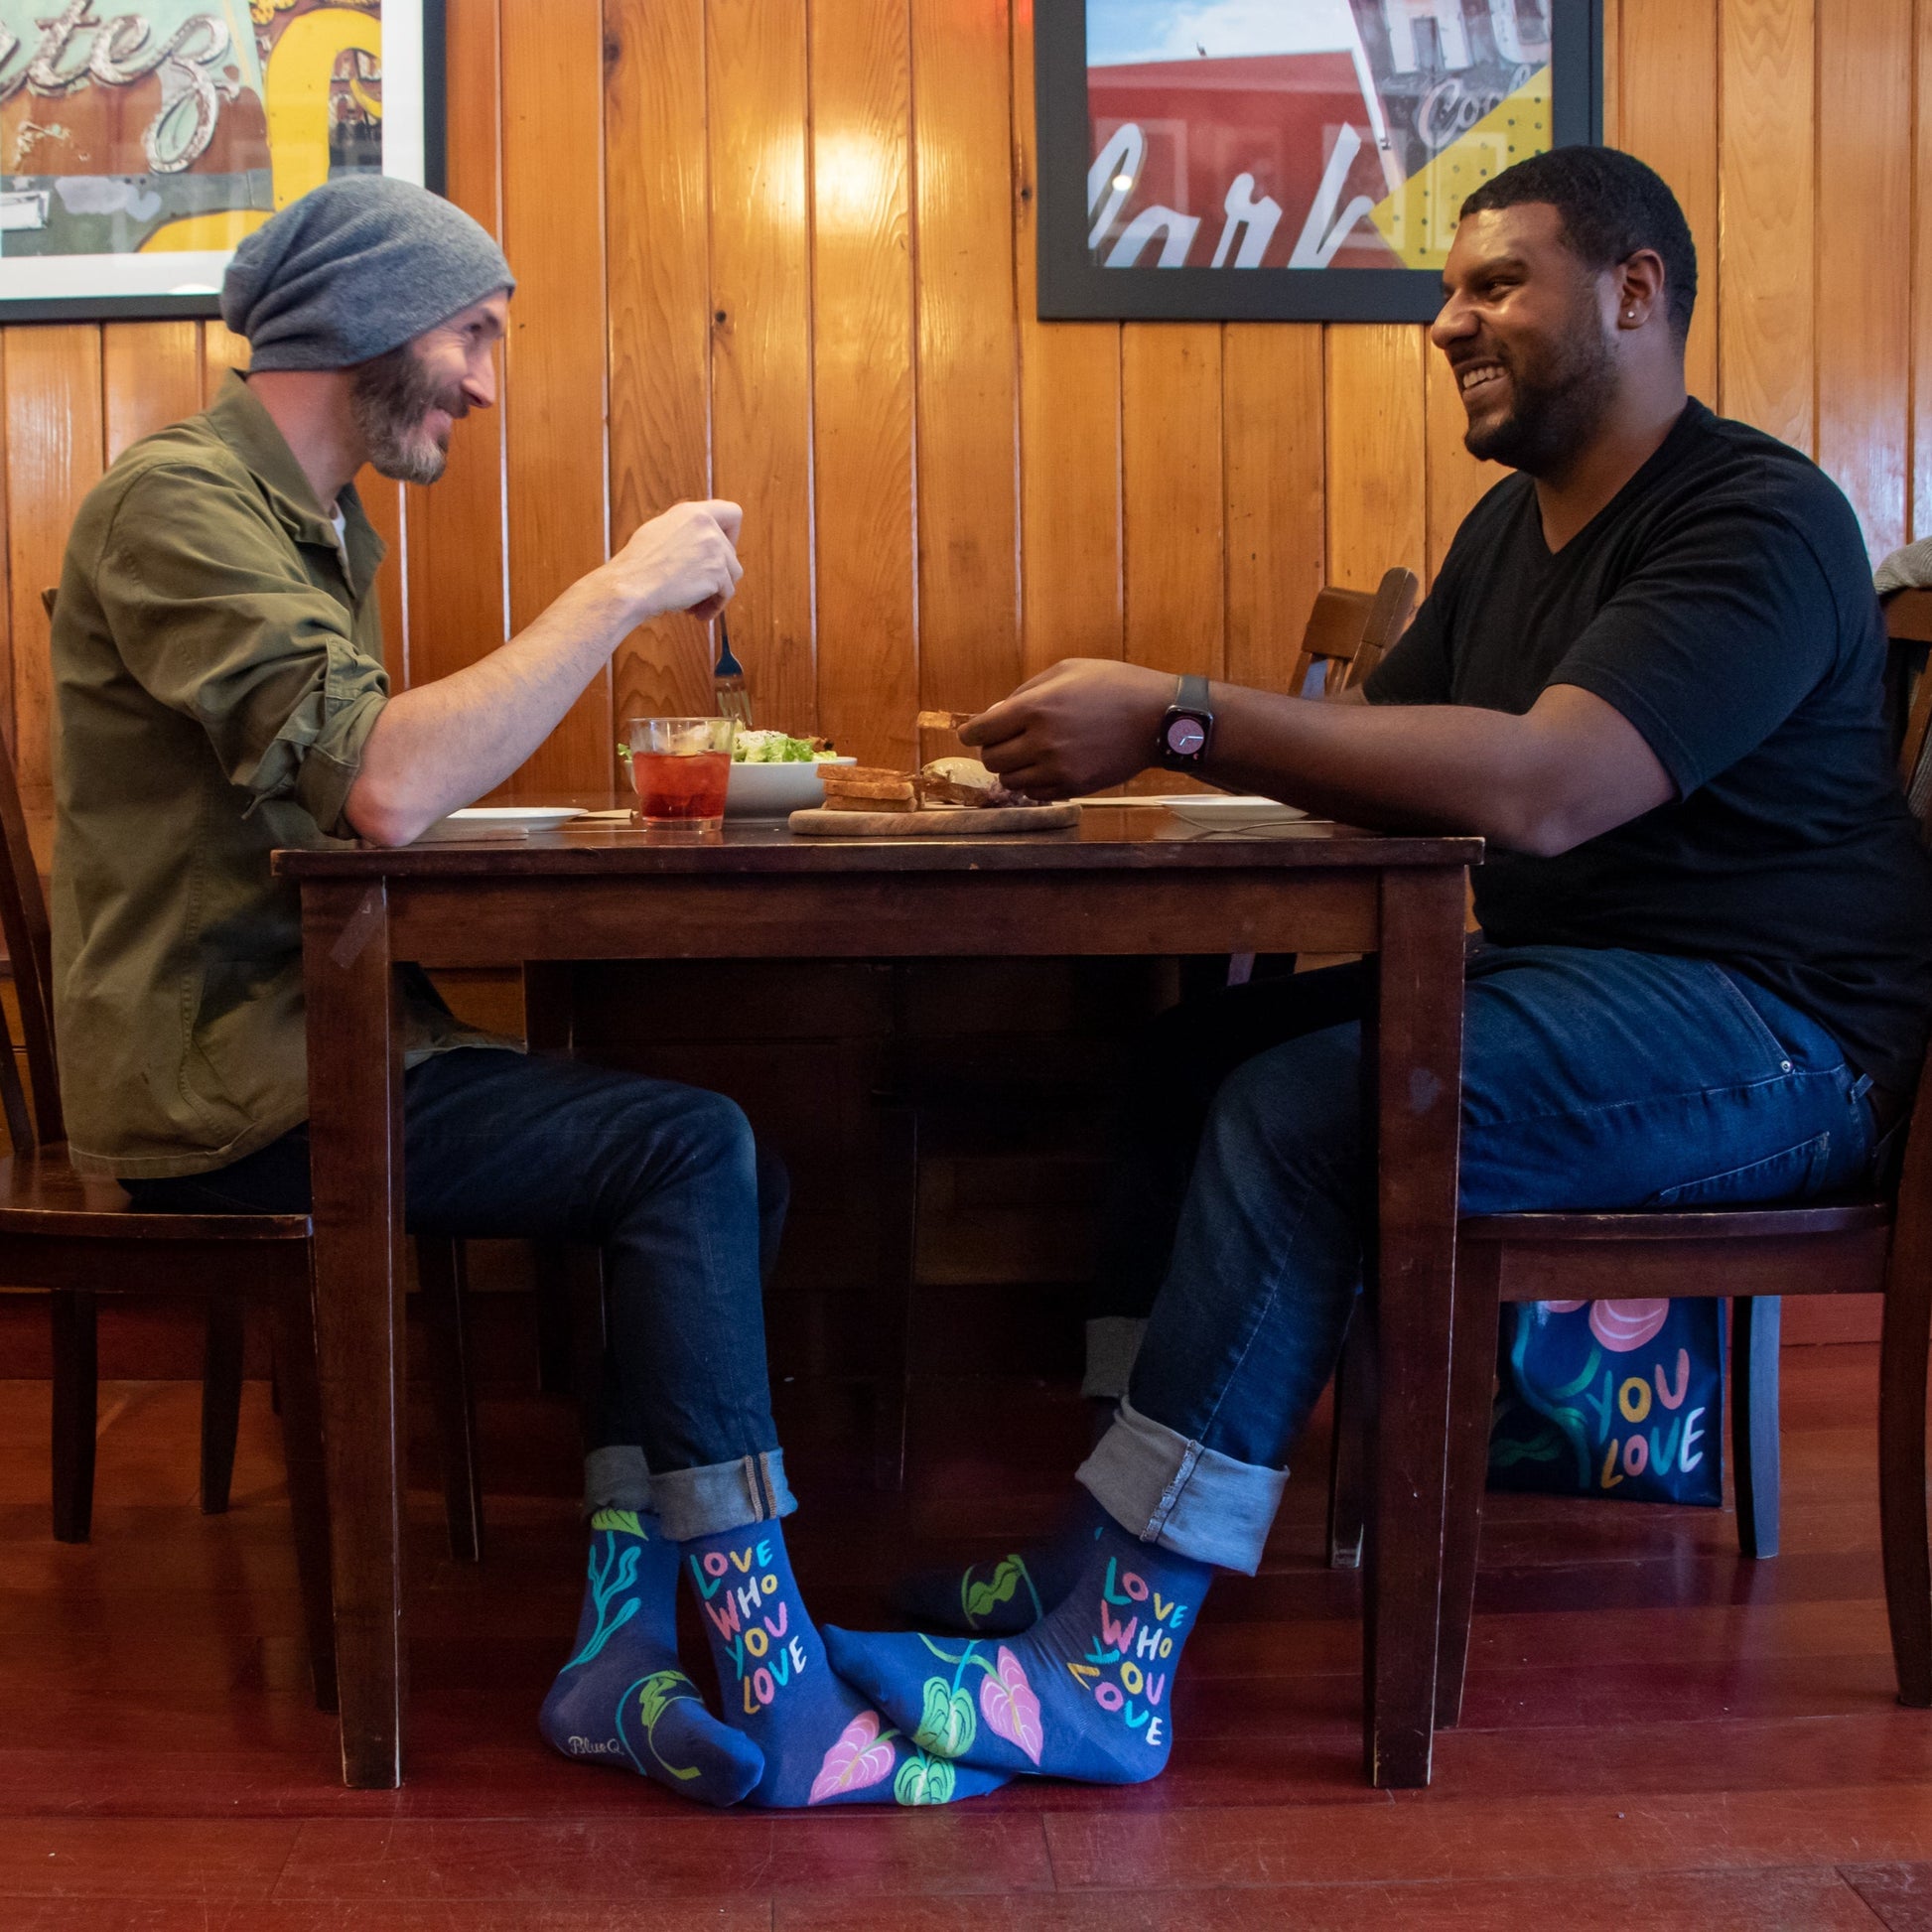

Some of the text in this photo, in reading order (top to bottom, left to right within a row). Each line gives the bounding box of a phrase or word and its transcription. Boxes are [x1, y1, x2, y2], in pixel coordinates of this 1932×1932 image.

[1586, 1347, 1690, 1446] YOU
[1600, 1406, 1706, 1489] LOVE
[690, 1539, 773, 1599] LOVE
[1104, 1556, 1188, 1629] LOVE
[705, 1574, 778, 1641] WHO
[724, 1601, 788, 1681] YOU
[1100, 1599, 1173, 1661] WHO
[744, 1635, 807, 1715] LOVE
[1066, 1661, 1164, 1746] LOVE
[1084, 1635, 1165, 1706] YOU
